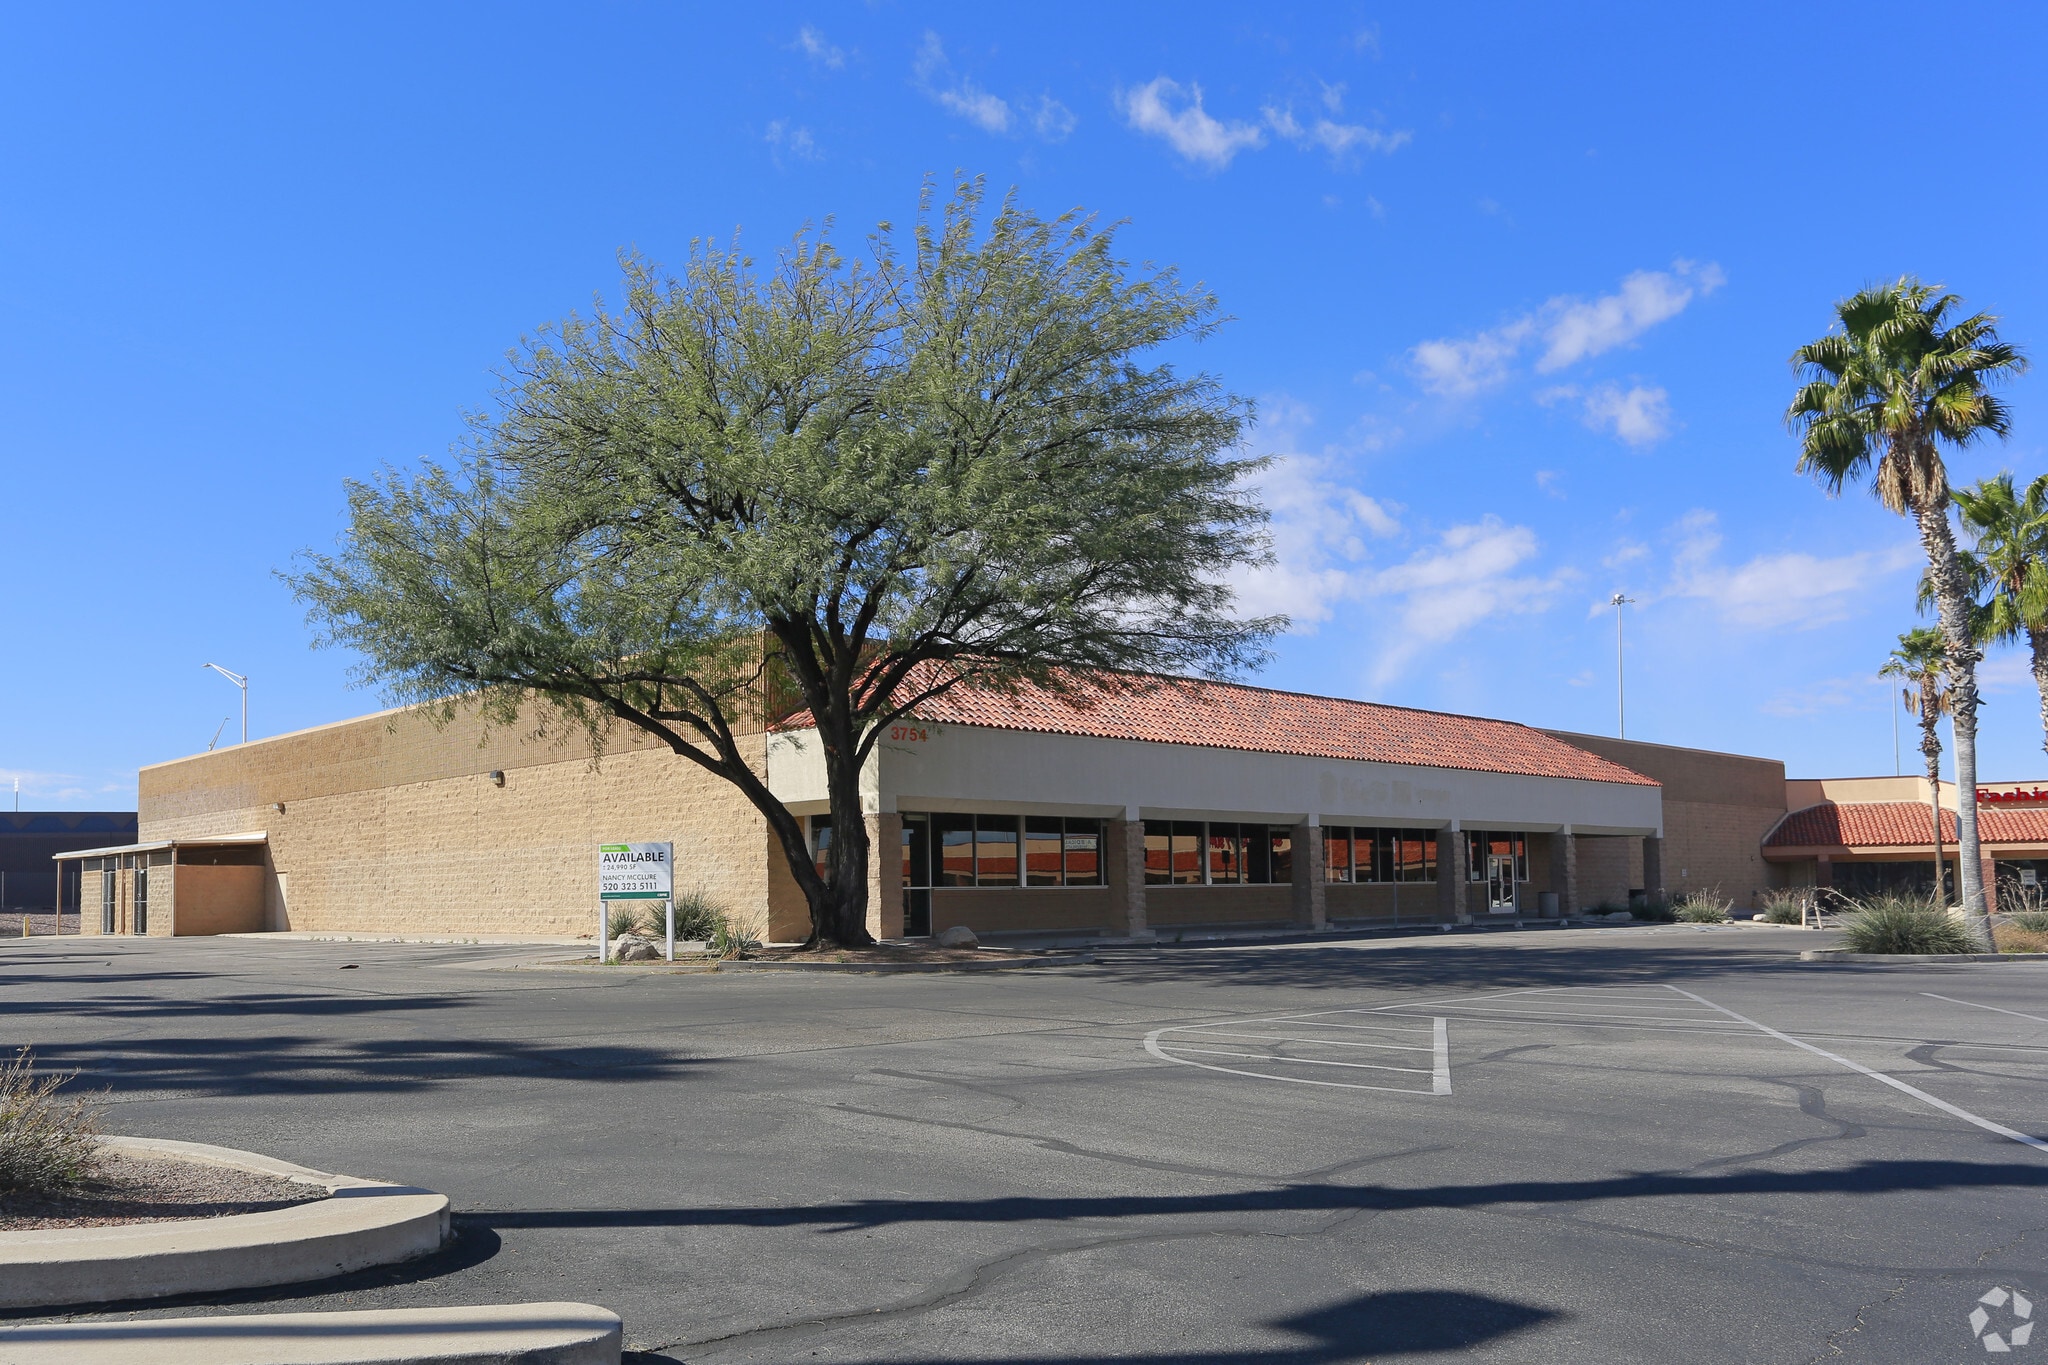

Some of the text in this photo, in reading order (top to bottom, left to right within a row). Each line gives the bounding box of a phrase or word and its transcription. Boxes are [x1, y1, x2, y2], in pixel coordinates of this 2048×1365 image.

[891, 726, 928, 742] 3754
[603, 852, 664, 863] AVAILABLE
[639, 882, 657, 890] 5111
